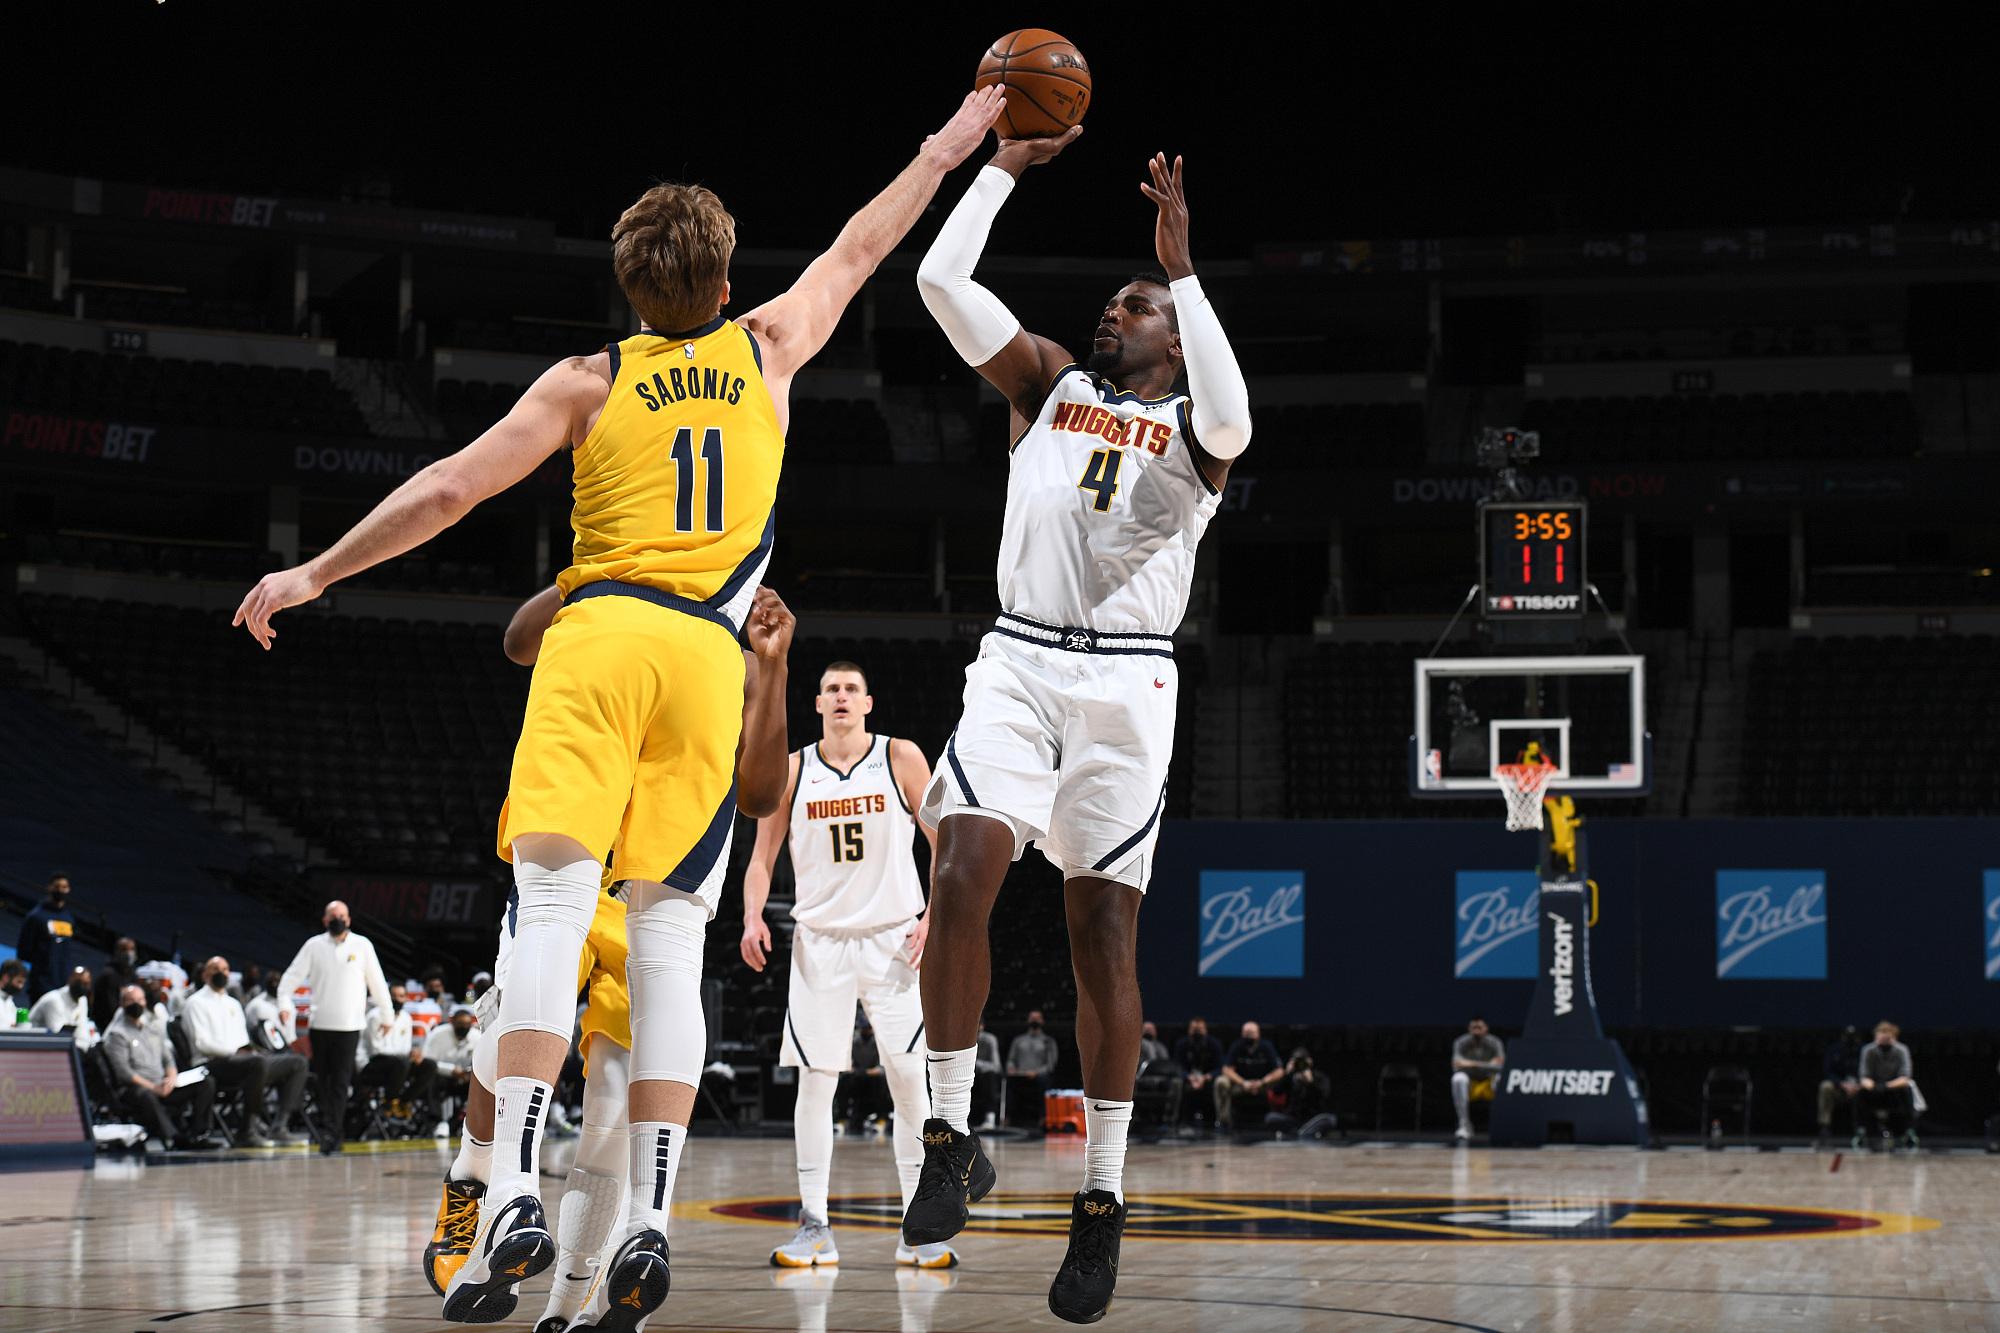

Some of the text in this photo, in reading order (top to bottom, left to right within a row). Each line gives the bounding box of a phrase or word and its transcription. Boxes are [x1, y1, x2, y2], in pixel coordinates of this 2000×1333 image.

[635, 366, 746, 412] SABONIS
[669, 426, 725, 533] 11
[1077, 448, 1124, 512] 4
[1588, 475, 1666, 497] NOW
[1514, 512, 1572, 540] 3:55
[1514, 594, 1580, 610] TISSOT
[806, 794, 885, 820] NUGGETS
[829, 822, 864, 863] 15
[1201, 884, 1305, 954] Ball
[1457, 886, 1540, 954] Bal
[1719, 883, 1826, 954] Ball
[1549, 916, 1574, 1016] verizon
[1507, 1069, 1615, 1095] POINTSBET
